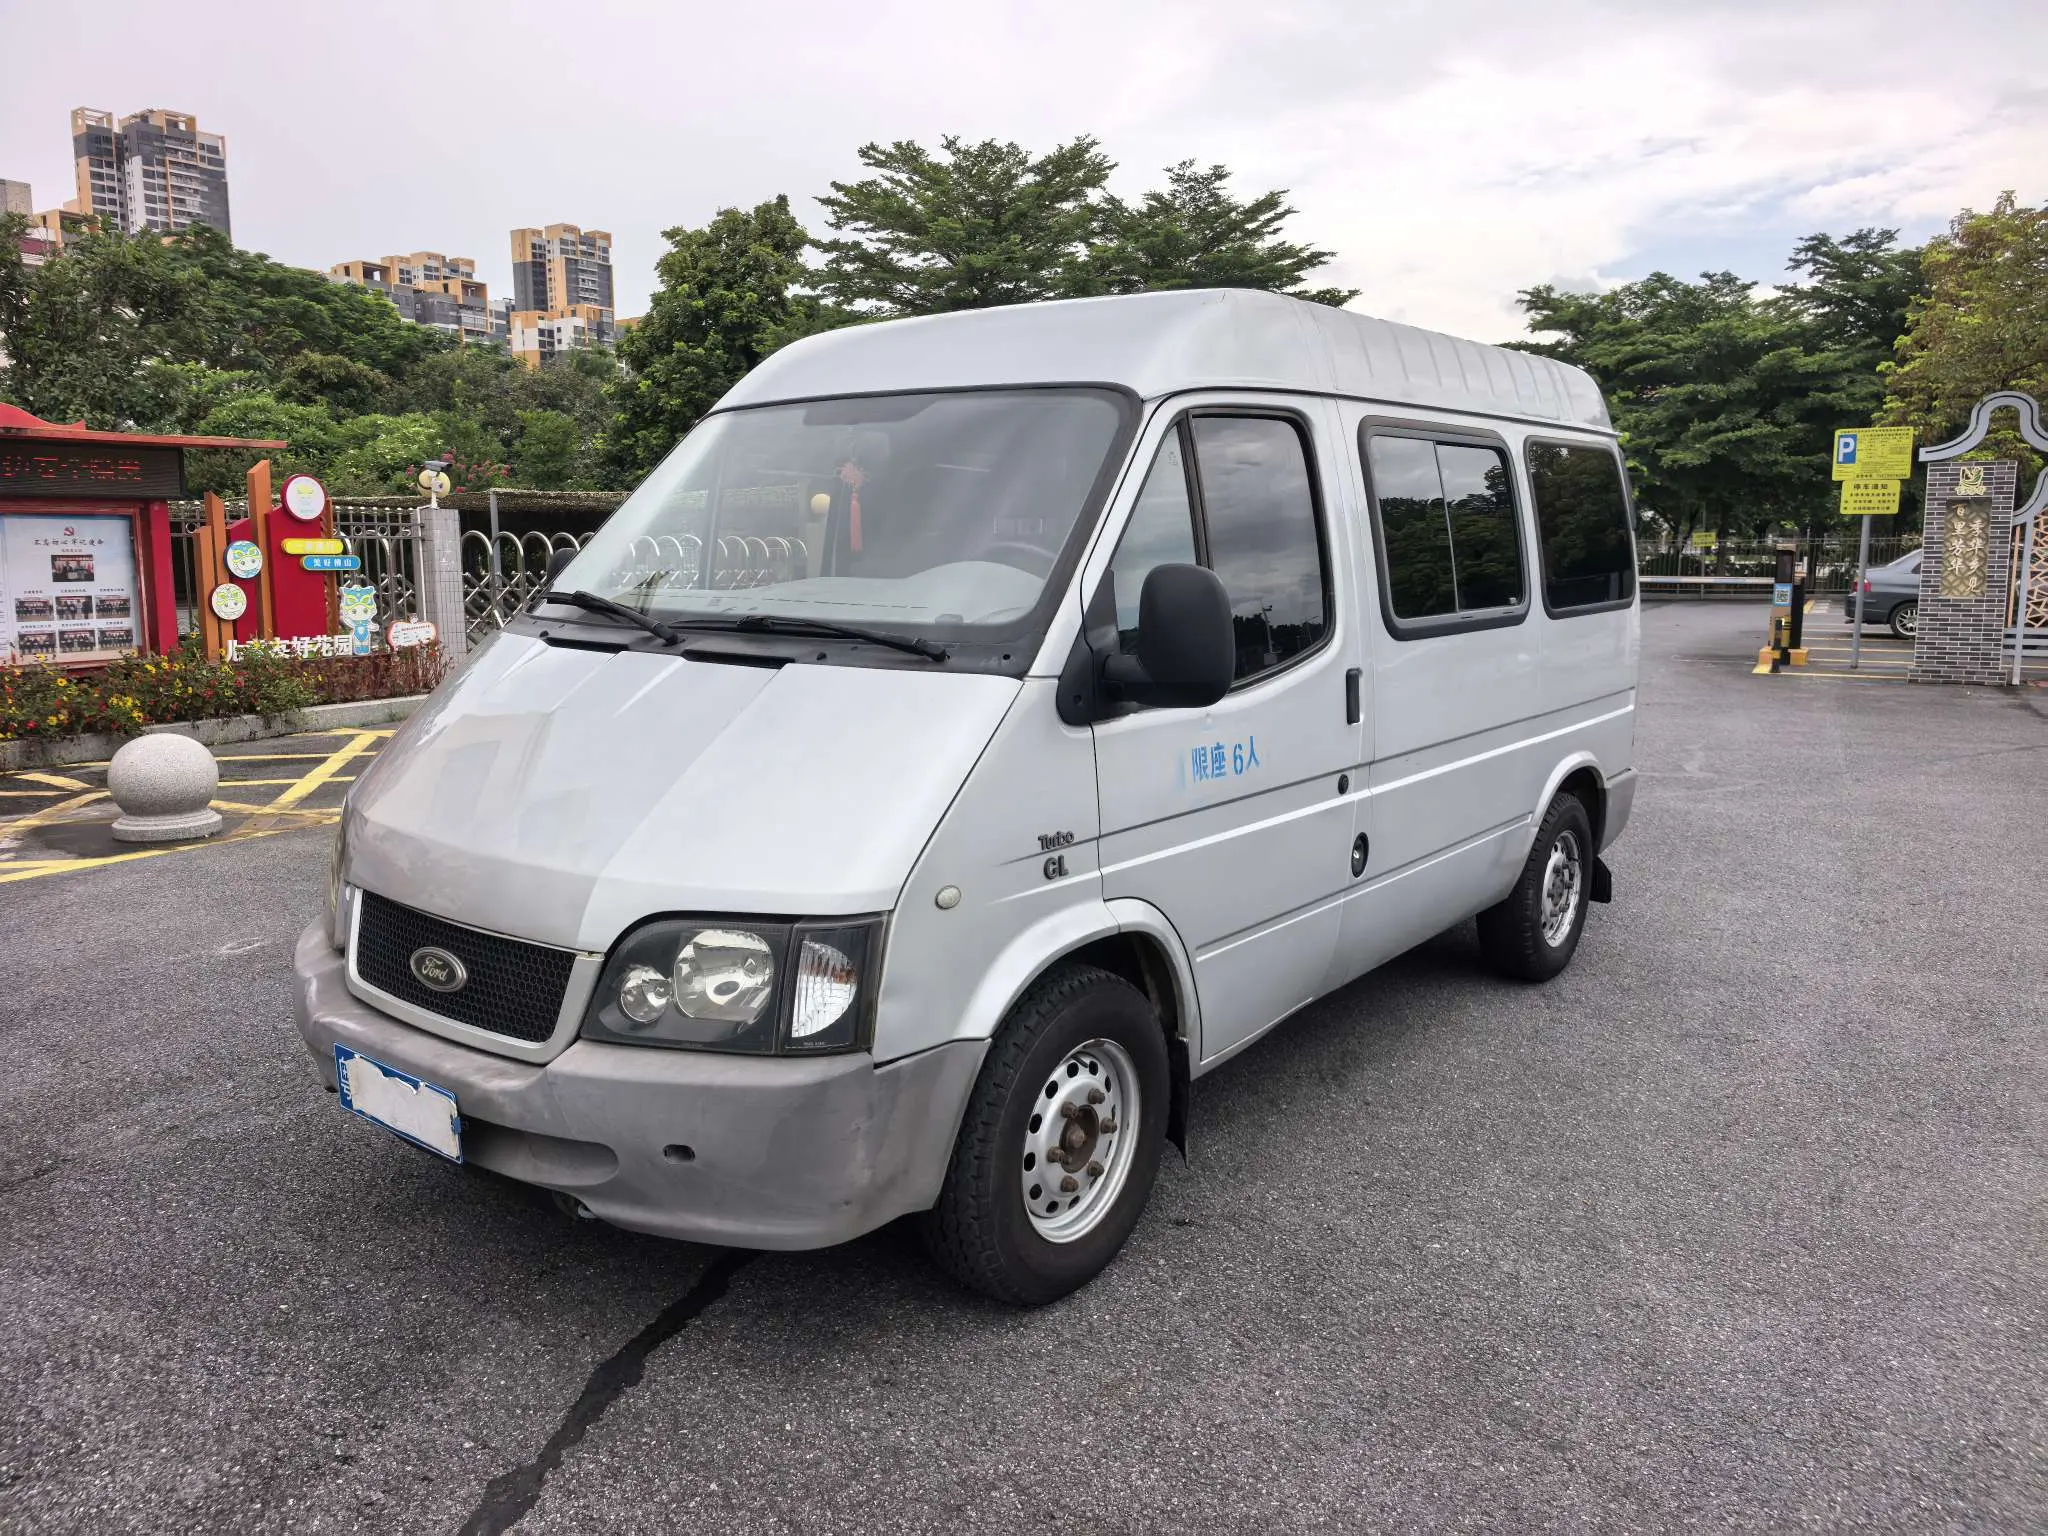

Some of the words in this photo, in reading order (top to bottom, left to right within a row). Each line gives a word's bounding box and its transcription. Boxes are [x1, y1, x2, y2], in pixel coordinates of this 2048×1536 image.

[1838, 437, 1855, 463] P
[226, 635, 353, 662] 儿友好花园
[1037, 830, 1075, 851] Turbo
[1043, 854, 1069, 881] GL
[422, 956, 449, 982] Ford
